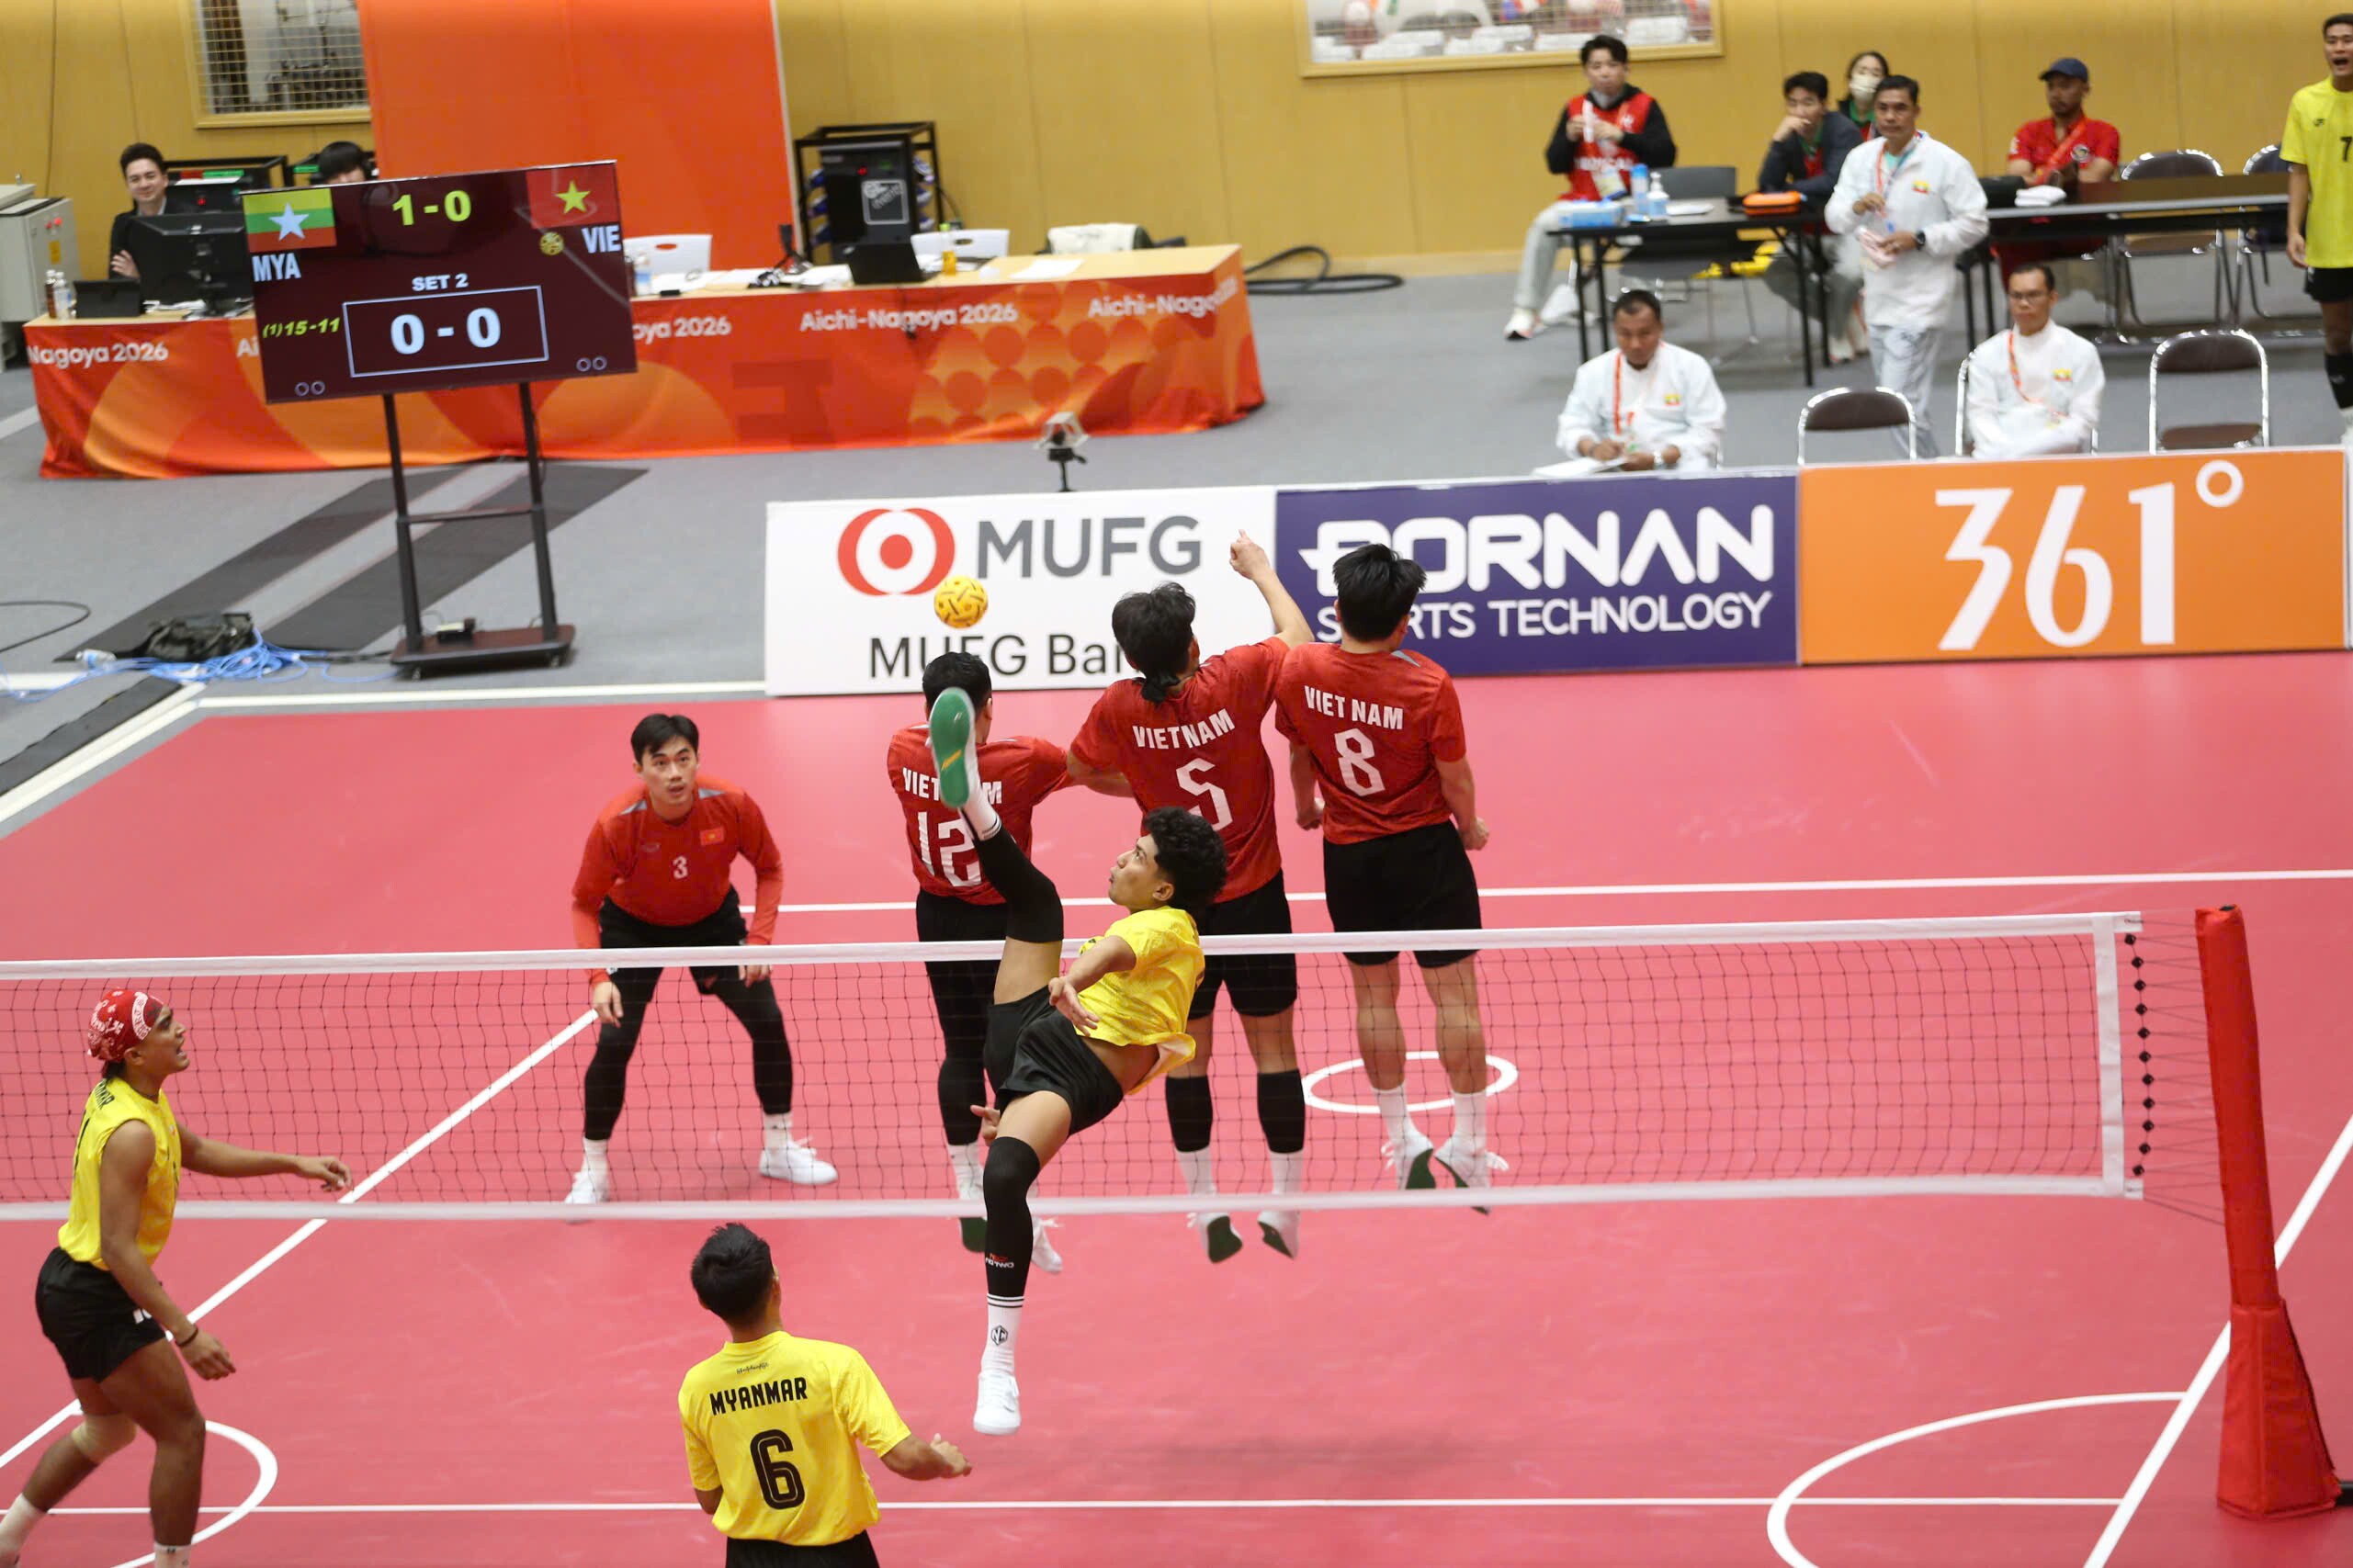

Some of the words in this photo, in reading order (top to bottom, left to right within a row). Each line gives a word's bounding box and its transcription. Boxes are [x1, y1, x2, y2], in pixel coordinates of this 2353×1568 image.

[2340, 135, 2353, 163] 7
[582, 225, 621, 254] VIE
[252, 253, 301, 282] MYA
[412, 276, 450, 292] SET
[455, 274, 469, 288] 2
[674, 316, 732, 337] 2026
[799, 308, 957, 333] Aichi-Nagoya
[959, 302, 1019, 324] 2026
[111, 341, 169, 363] 2026
[978, 515, 1201, 579] MUFG
[1317, 601, 1476, 642] SRTS
[1488, 591, 1772, 637] TECHNOLOGY
[1334, 728, 1385, 796] 8
[1176, 758, 1233, 831] 5
[918, 811, 981, 887] 12
[673, 855, 688, 879] 3
[709, 1377, 808, 1416] MYANMAR
[750, 1428, 806, 1510] 6
